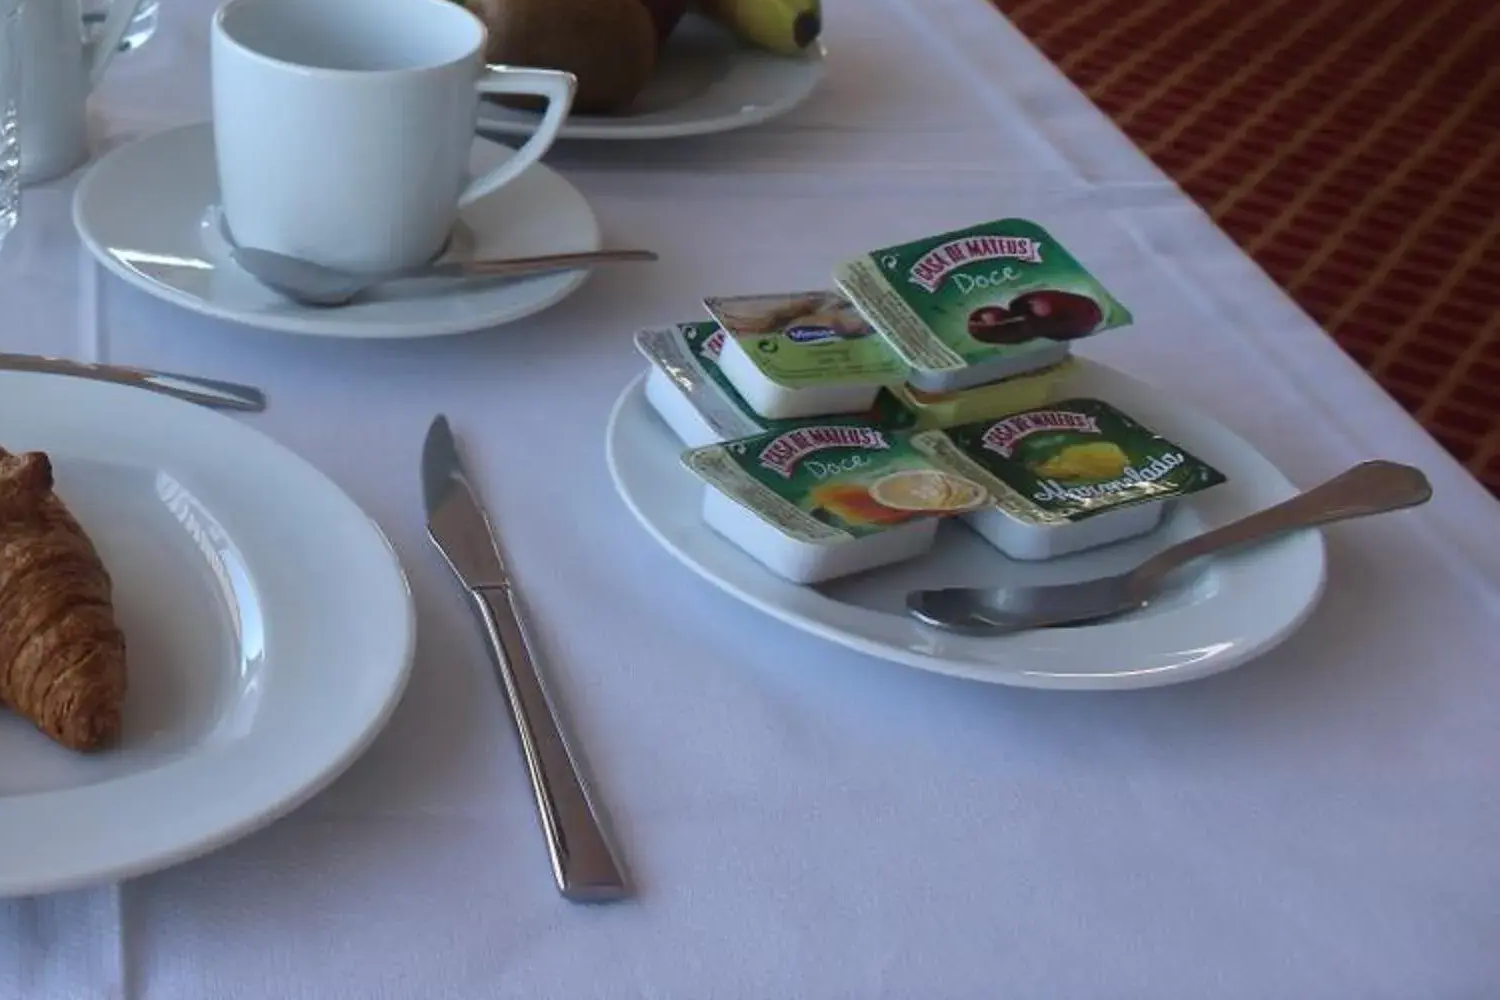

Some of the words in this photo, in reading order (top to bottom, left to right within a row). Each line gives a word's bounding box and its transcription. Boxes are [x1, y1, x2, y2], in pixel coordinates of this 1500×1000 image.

[913, 251, 950, 281] CASA
[945, 243, 966, 264] DE
[965, 238, 1028, 259] MATEUS
[951, 266, 1022, 294] Doce
[803, 455, 871, 480] Doce
[1033, 451, 1185, 501] Marmelada
